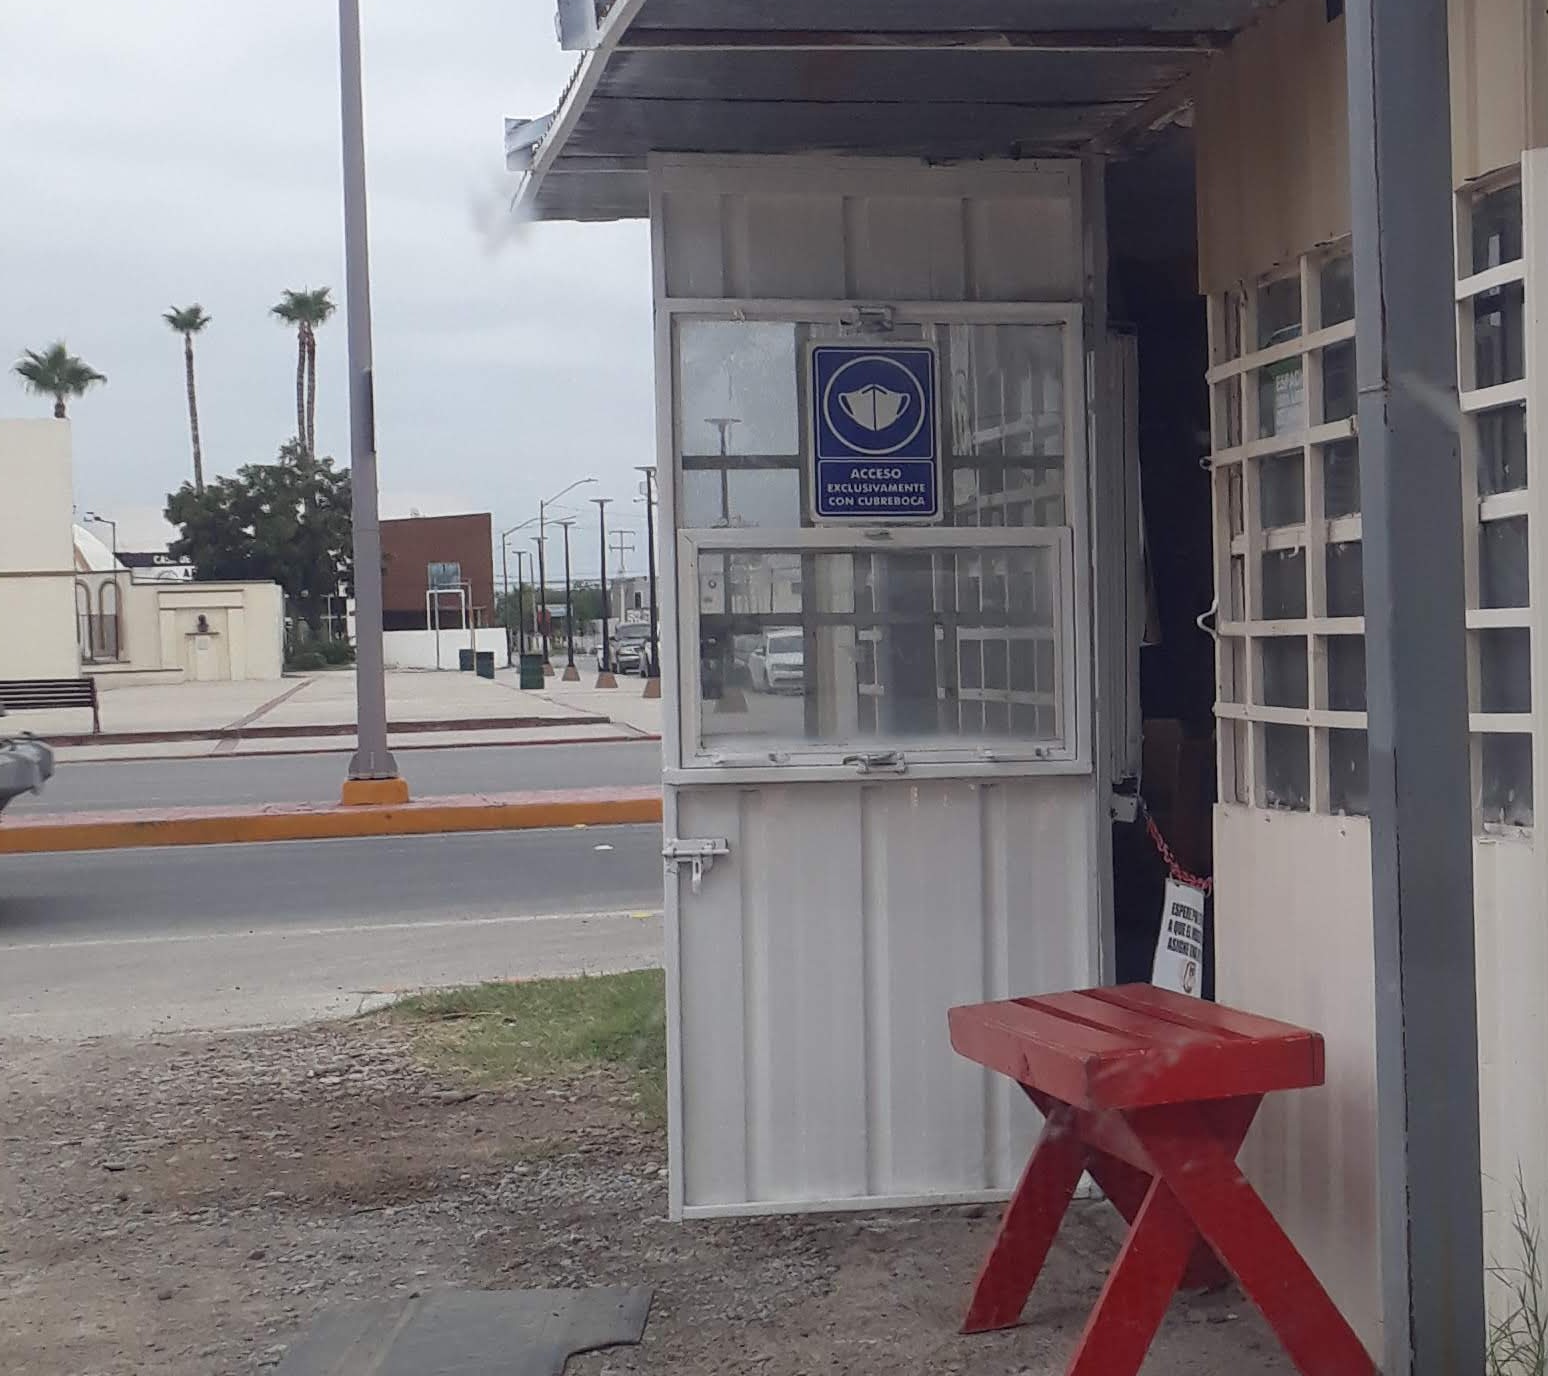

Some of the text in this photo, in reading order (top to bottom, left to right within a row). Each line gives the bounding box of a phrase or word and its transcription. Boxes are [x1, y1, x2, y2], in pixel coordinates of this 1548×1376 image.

[850, 468, 902, 480] ACCESO
[827, 483, 926, 494] EXCLUSIVAMENTE
[828, 496, 926, 506] CON CUBREBOCA
